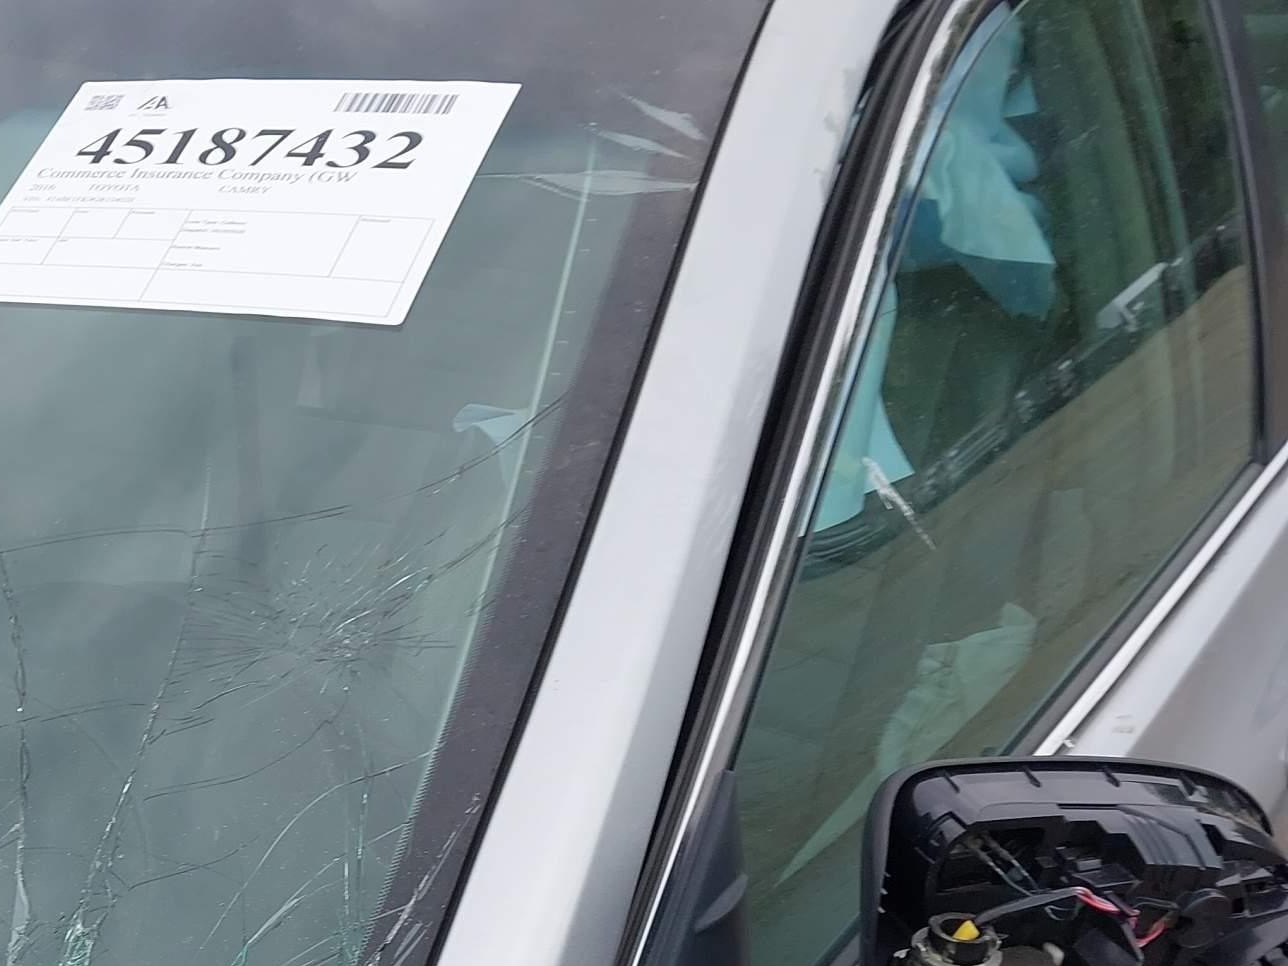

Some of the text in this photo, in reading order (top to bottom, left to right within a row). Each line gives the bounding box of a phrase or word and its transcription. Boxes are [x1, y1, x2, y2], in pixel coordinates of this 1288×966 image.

[76, 127, 424, 170] 45187432
[36, 167, 359, 185] Commerce Insurance Company (GW
